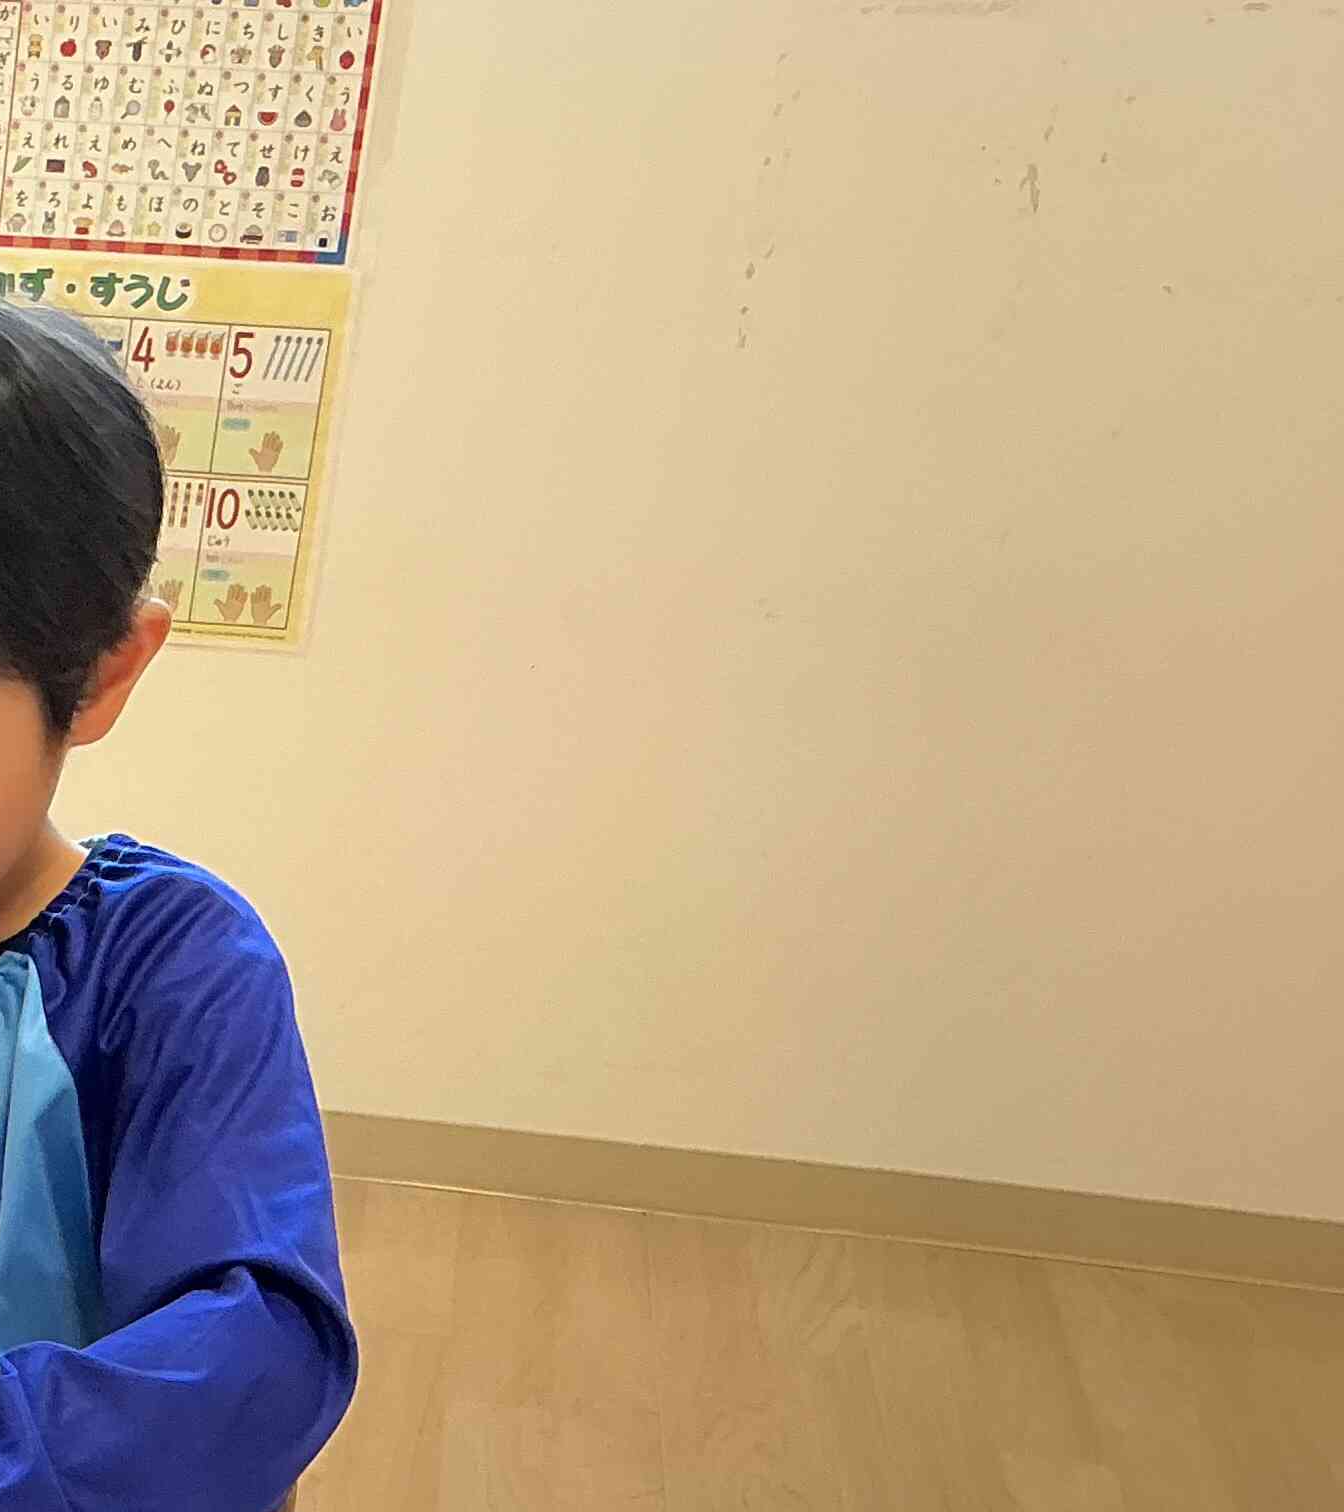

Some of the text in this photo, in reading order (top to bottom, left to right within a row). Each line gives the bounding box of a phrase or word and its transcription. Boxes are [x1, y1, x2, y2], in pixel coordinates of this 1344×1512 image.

[0, 5, 16, 21] が
[34, 14, 361, 42] い り い み ひ に ち し き い
[30, 73, 350, 104] う る ゆ む ふ ぬ つ す く う
[24, 133, 343, 163] え れ え め へ ね て せ け え
[16, 190, 336, 222] を ろ よ も ほ の と そ こ お
[131, 326, 155, 372] 4
[229, 332, 255, 379] 5
[206, 487, 240, 530] 10
